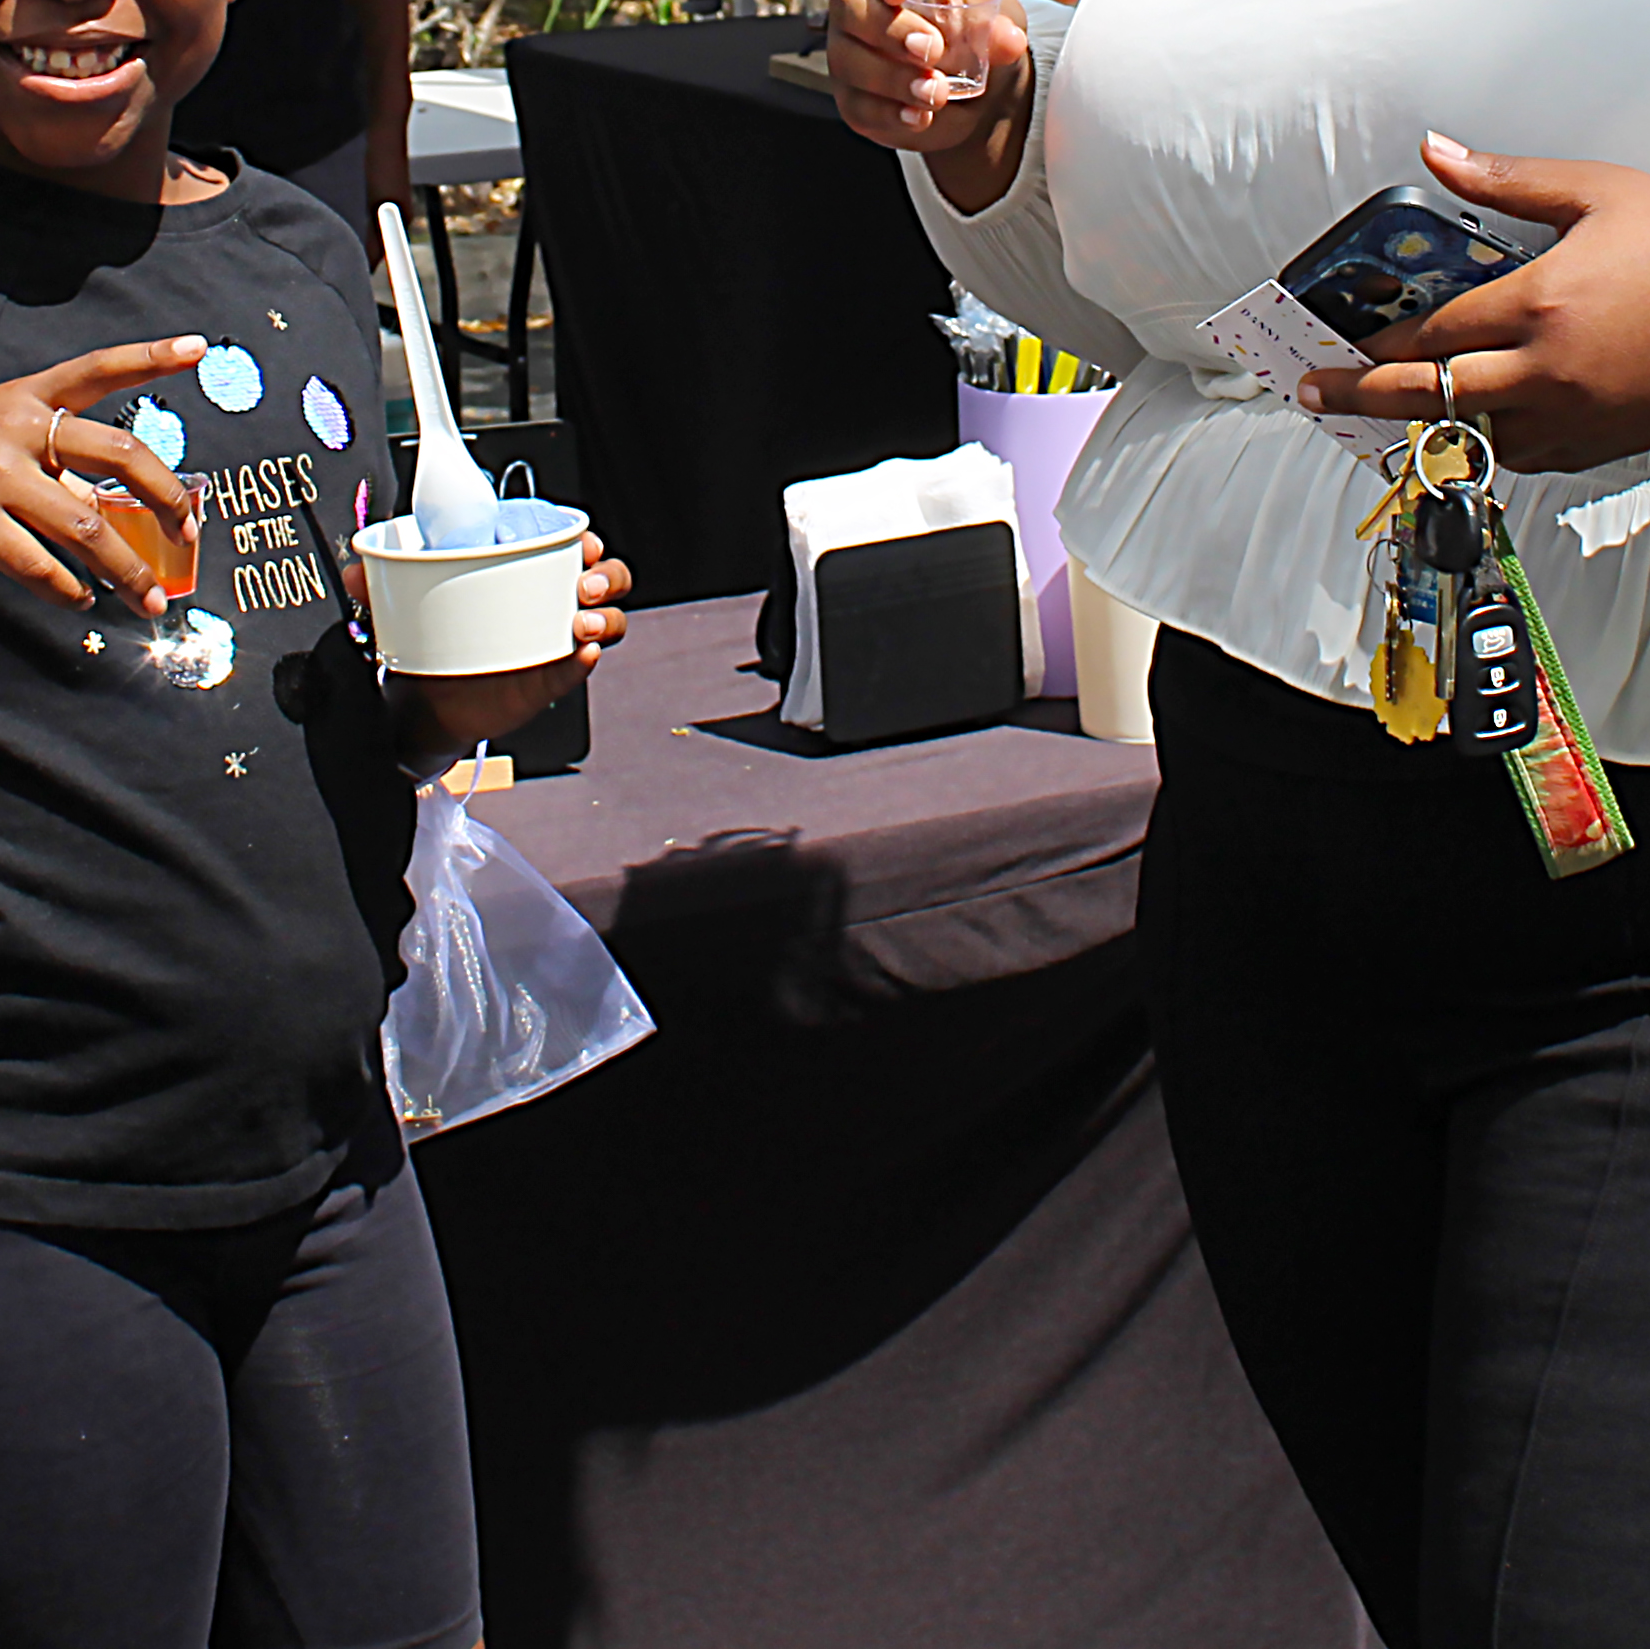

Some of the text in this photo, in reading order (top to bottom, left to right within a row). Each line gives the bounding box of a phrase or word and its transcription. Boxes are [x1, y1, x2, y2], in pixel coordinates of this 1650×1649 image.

[1240, 308, 1283, 342] DANNY
[199, 453, 318, 522] PHASES
[233, 515, 300, 554] OF THE
[233, 553, 327, 613] MOON
